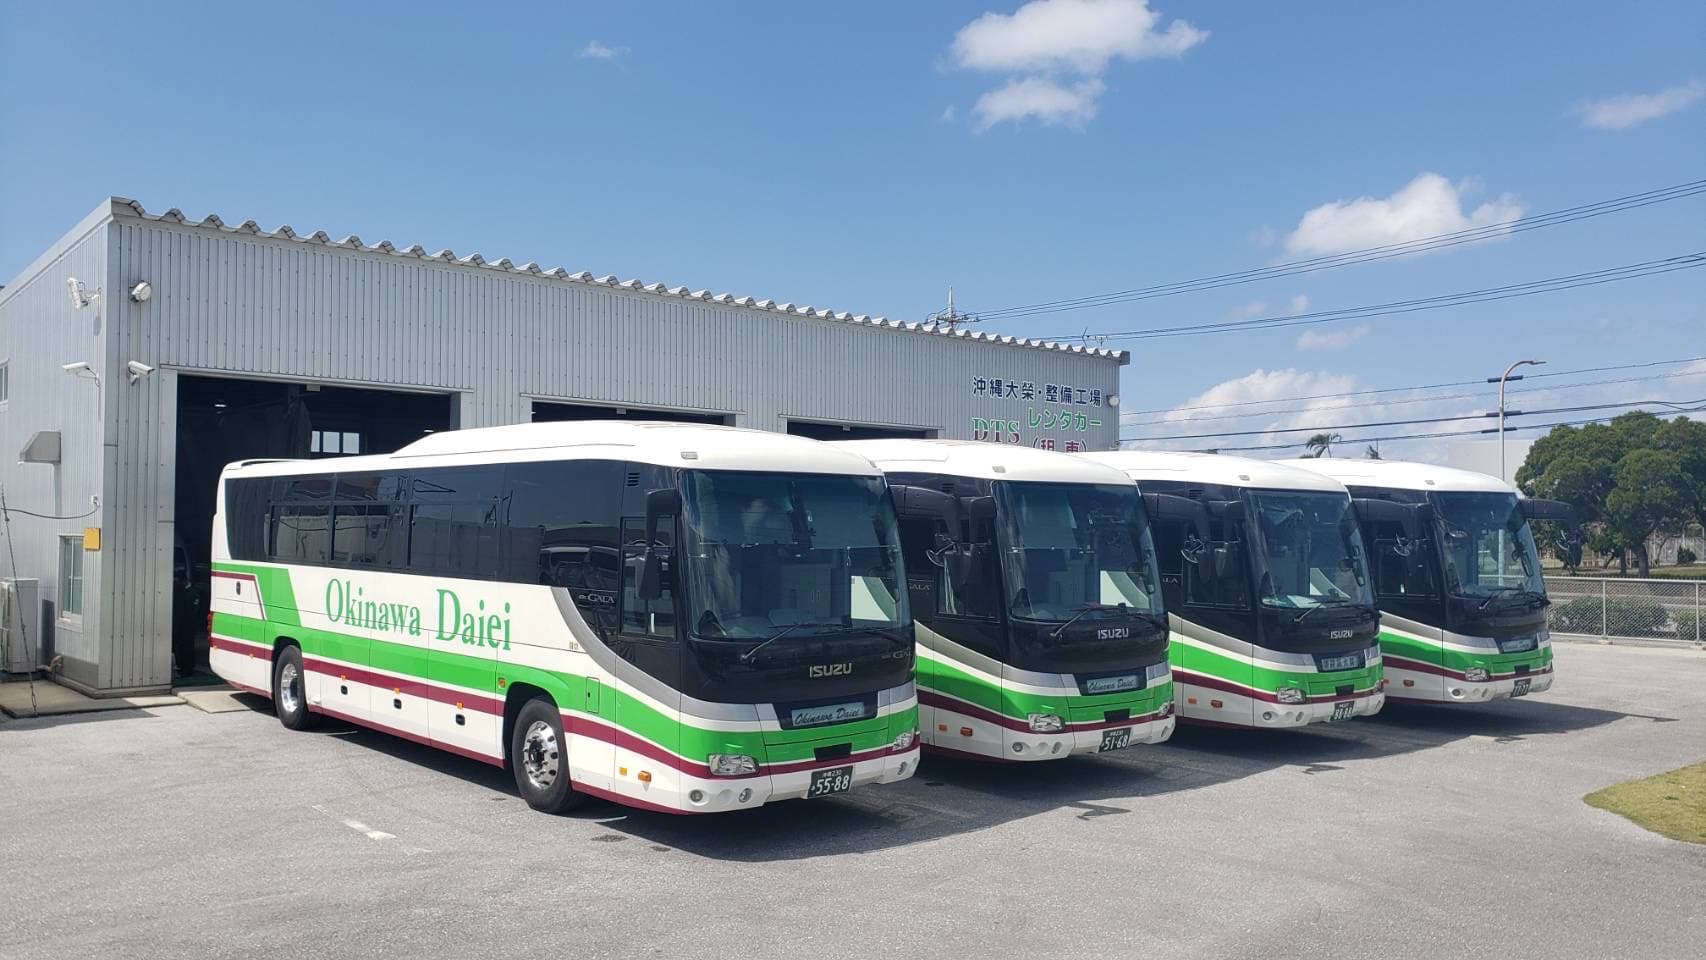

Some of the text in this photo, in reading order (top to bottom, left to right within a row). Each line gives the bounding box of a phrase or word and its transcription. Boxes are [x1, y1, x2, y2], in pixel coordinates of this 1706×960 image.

[1027, 407, 1102, 431] レンタカー
[971, 417, 1020, 444] DTS
[325, 578, 512, 651] Okinawa Daiei
[1097, 628, 1129, 640] ISUZU
[1330, 630, 1353, 639] ISUZU
[809, 662, 852, 678] ISUZU
